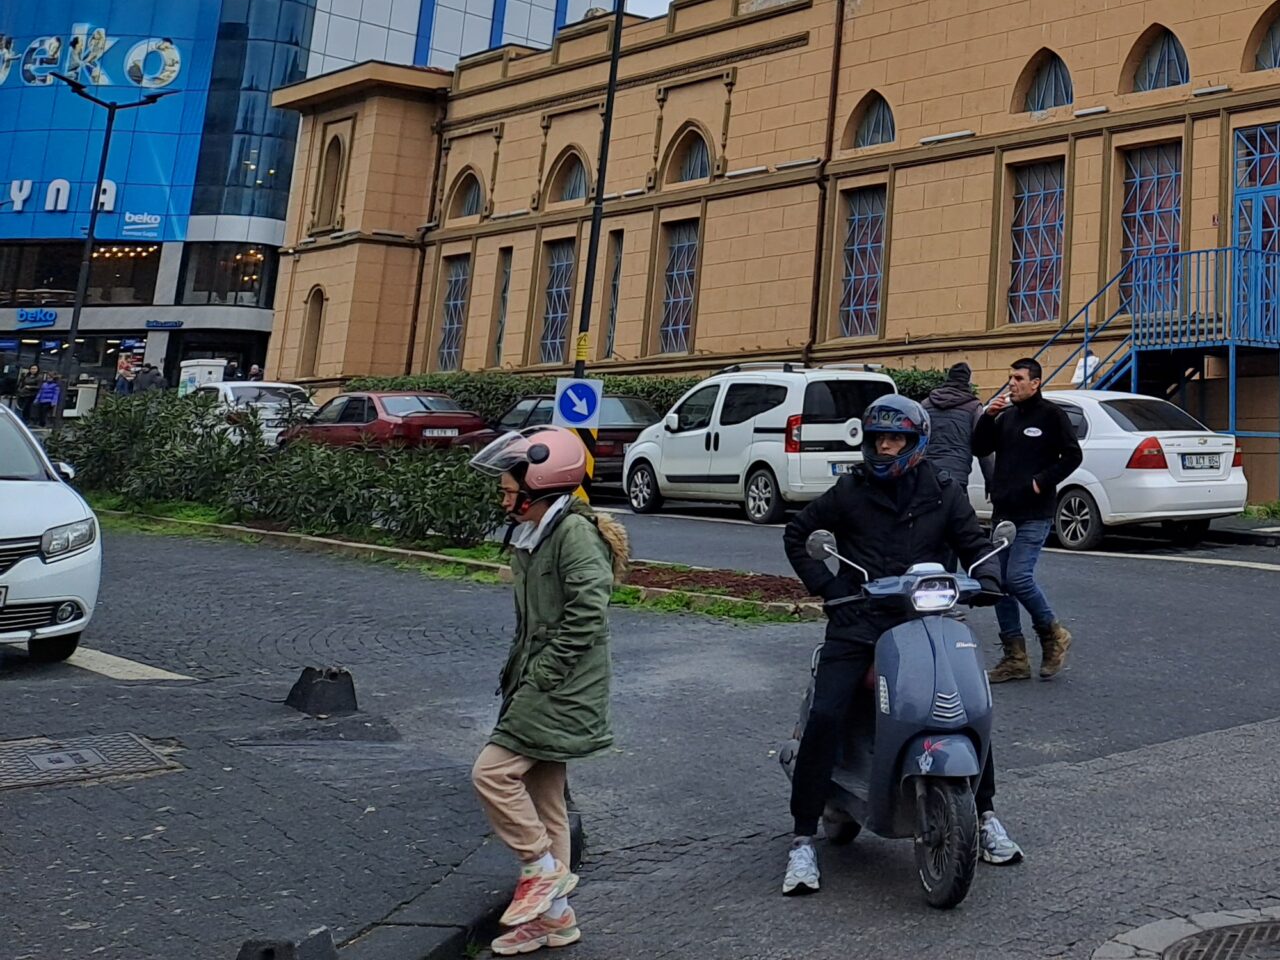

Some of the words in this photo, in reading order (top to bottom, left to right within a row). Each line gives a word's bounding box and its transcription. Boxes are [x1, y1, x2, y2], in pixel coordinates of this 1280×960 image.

[0, 22, 181, 88] eko
[125, 212, 161, 224] beko
[16, 308, 57, 322] beko
